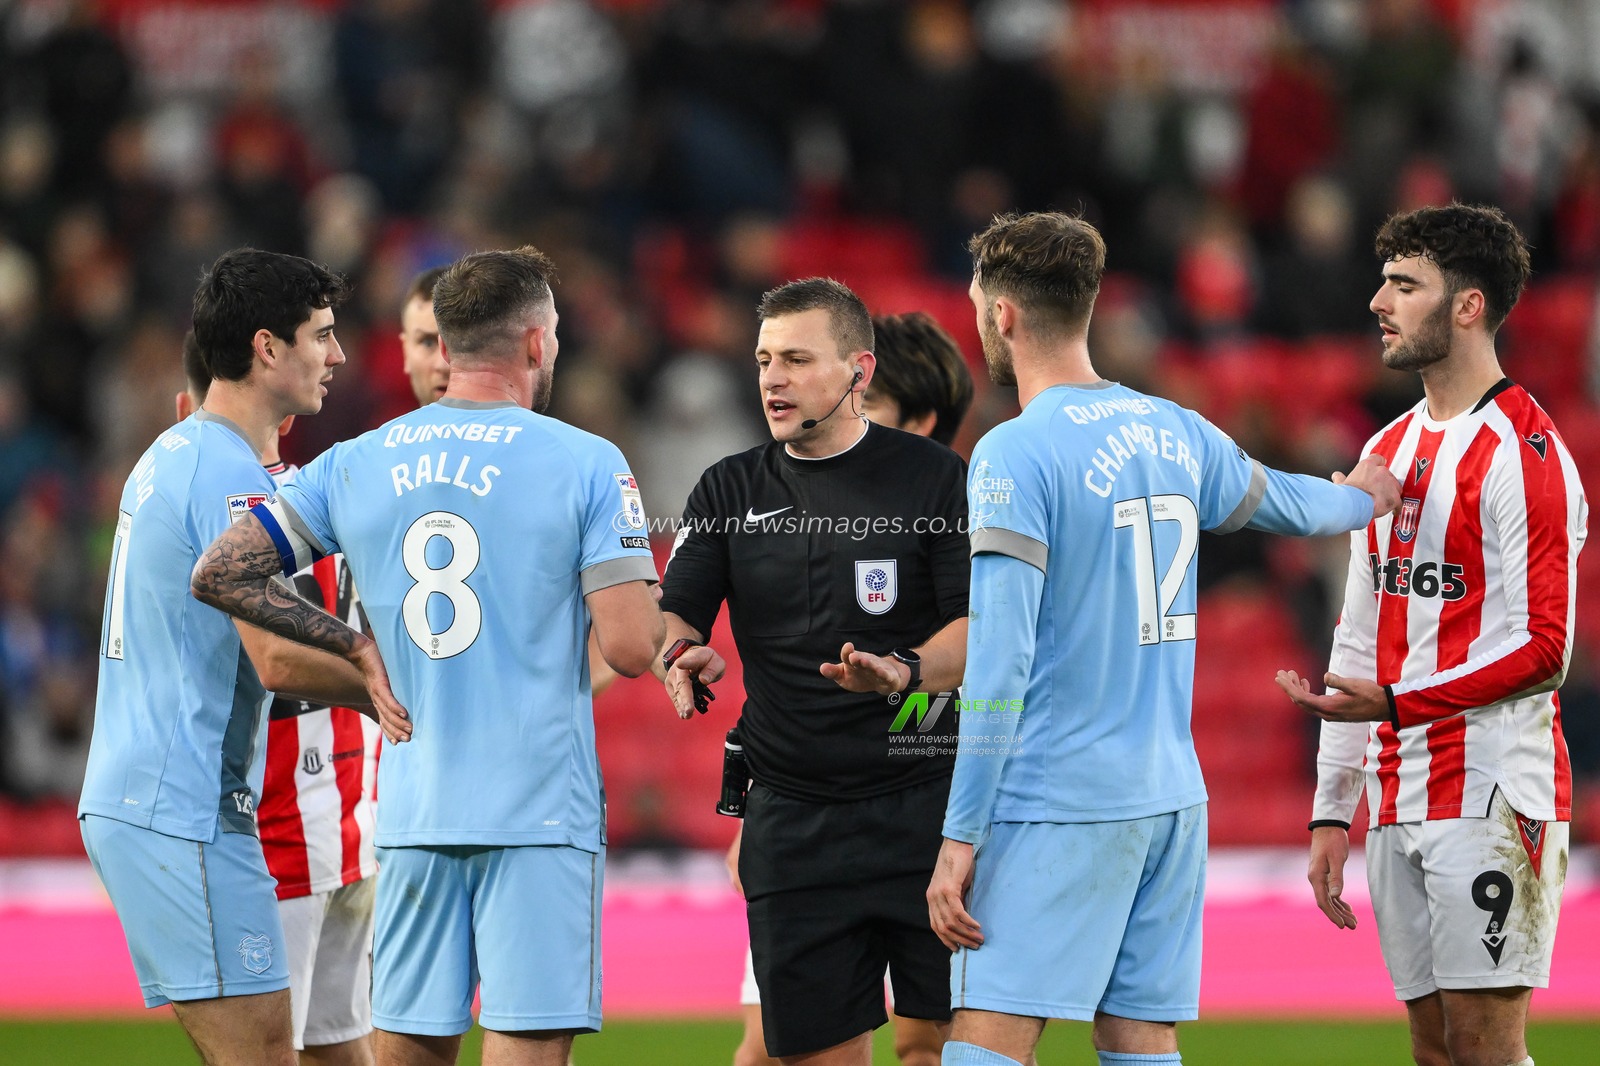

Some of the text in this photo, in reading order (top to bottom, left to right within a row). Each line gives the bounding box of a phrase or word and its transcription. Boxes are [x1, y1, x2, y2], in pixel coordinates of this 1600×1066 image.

[1063, 398, 1159, 425] QUINNBET
[384, 423, 523, 448] QUINNBET
[390, 451, 501, 497] RALLS
[1085, 421, 1201, 498] CHAMBERS
[231, 499, 247, 508] sky
[978, 491, 1011, 504] BATH
[402, 510, 482, 660] 8
[1114, 494, 1199, 646] 12
[868, 593, 887, 603] EFL
[1471, 870, 1514, 935] 9
